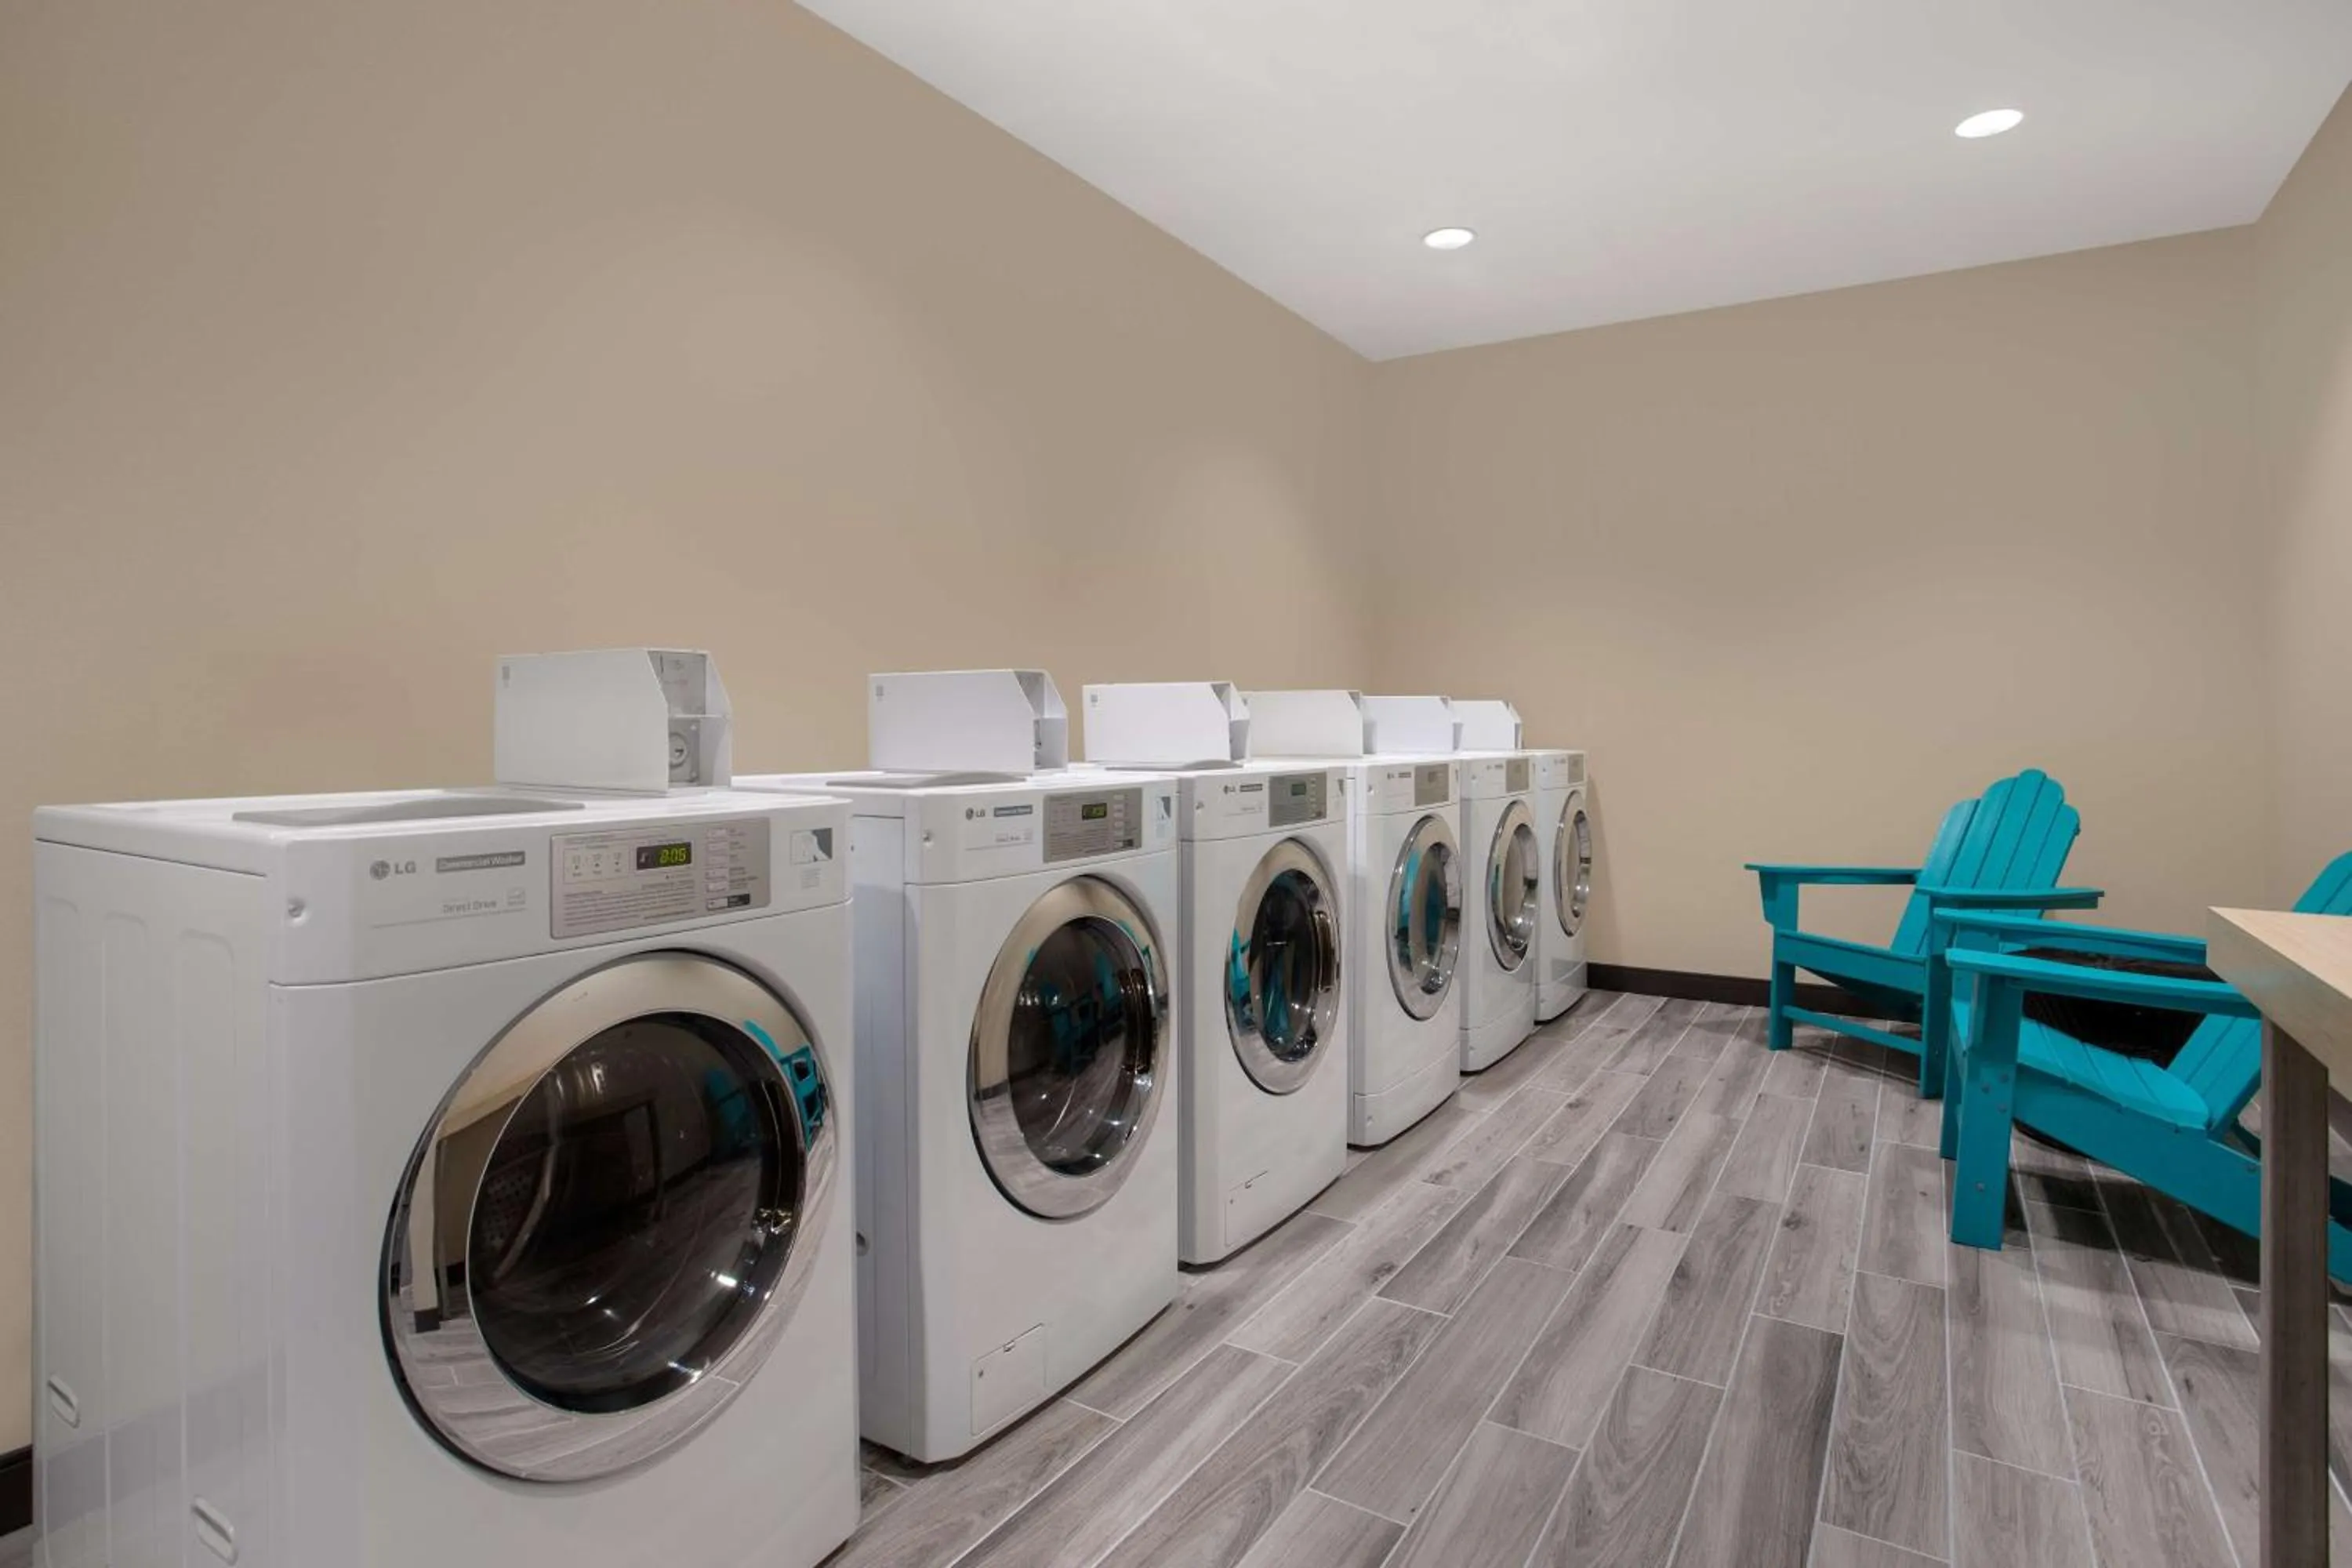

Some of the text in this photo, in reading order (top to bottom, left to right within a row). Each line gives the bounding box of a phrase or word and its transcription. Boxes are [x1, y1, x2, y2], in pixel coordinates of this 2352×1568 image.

[394, 861, 416, 874] LG
[443, 902, 470, 914] Direct
[472, 900, 497, 911] Drive
